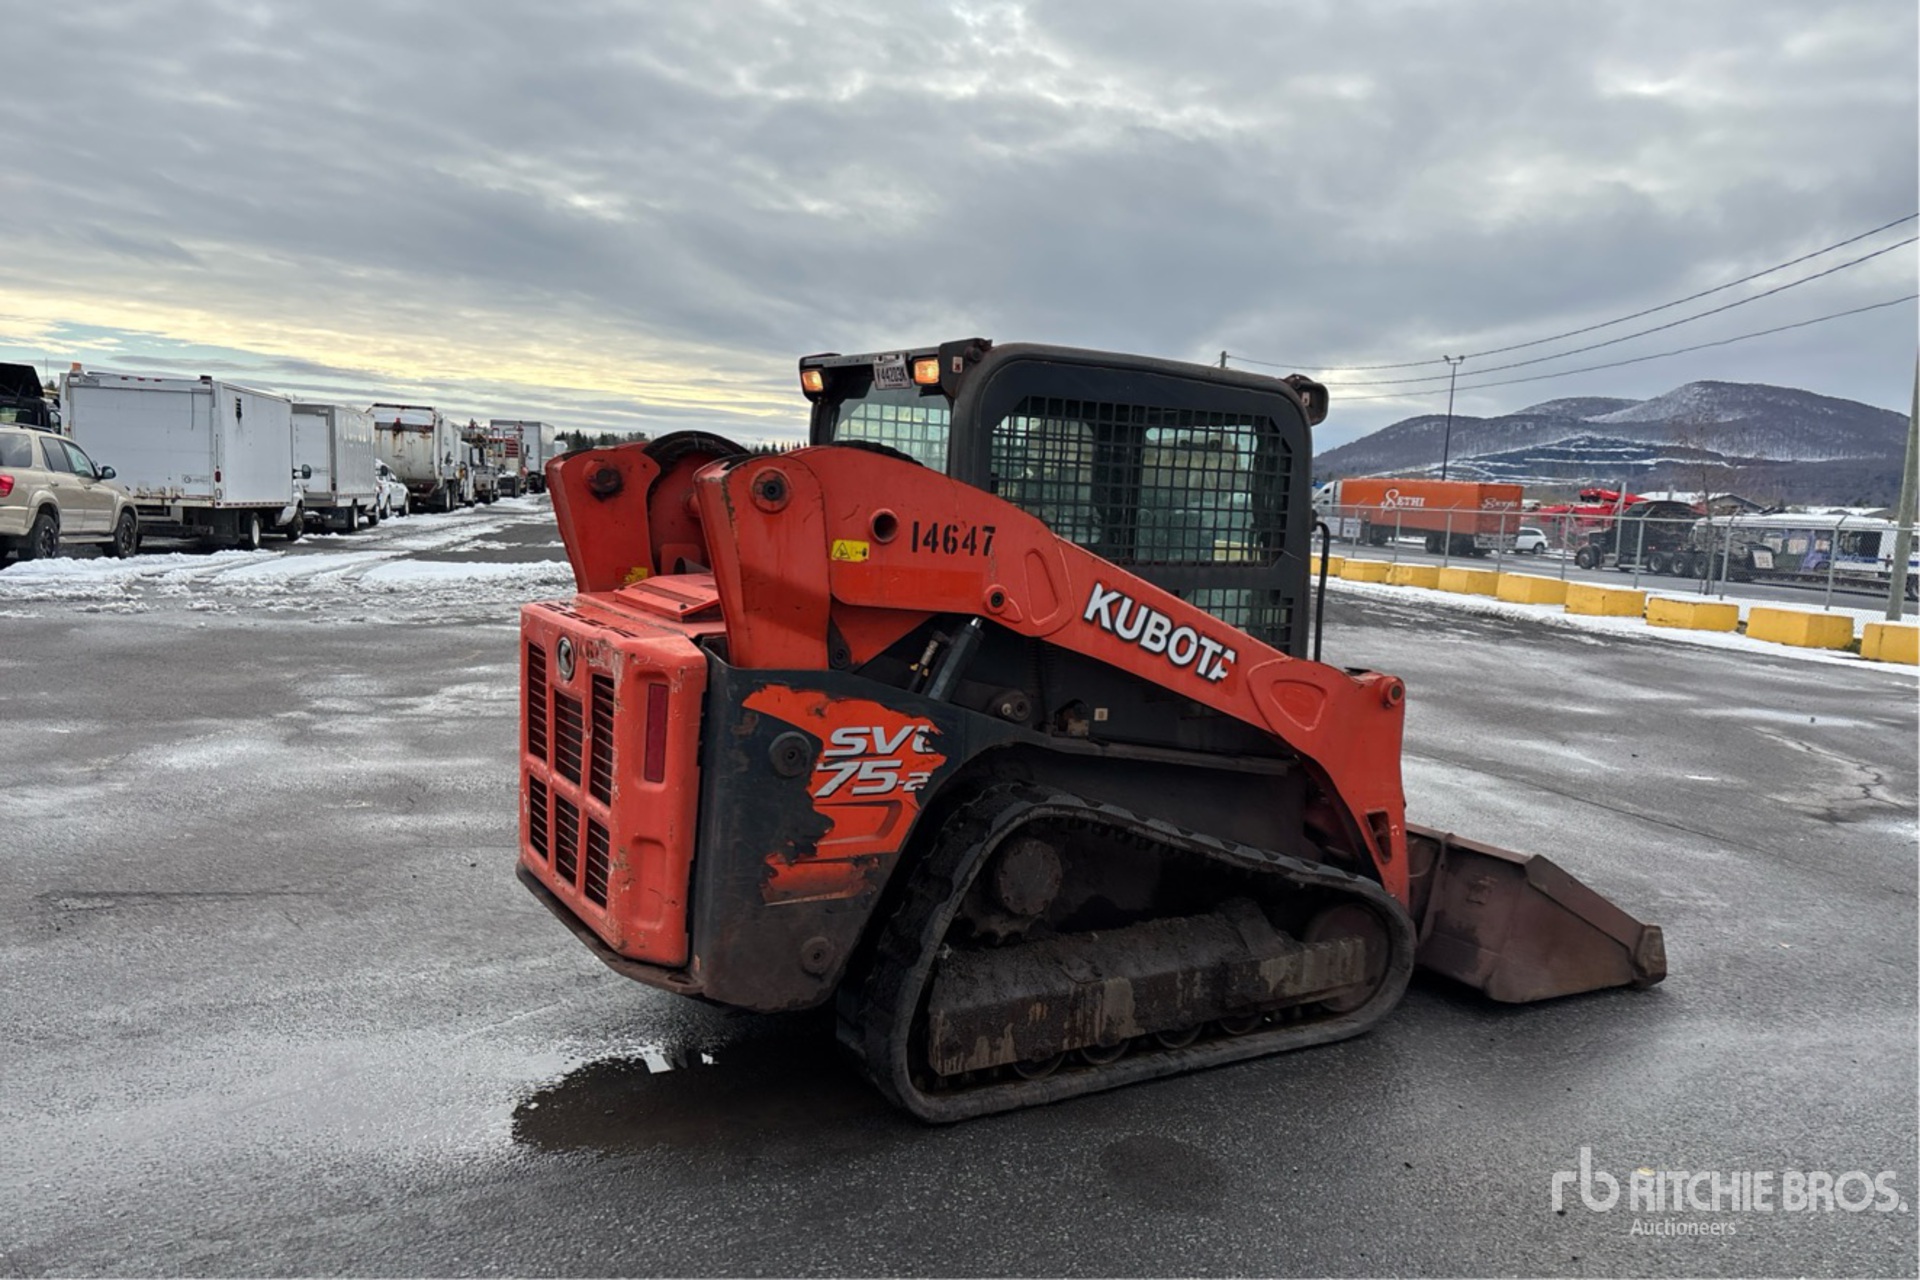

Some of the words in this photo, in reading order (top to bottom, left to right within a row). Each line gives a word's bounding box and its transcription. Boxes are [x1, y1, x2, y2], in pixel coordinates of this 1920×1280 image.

[1380, 488, 1426, 510] SETHI
[912, 521, 996, 557] 14647
[814, 760, 932, 797] 75-2
